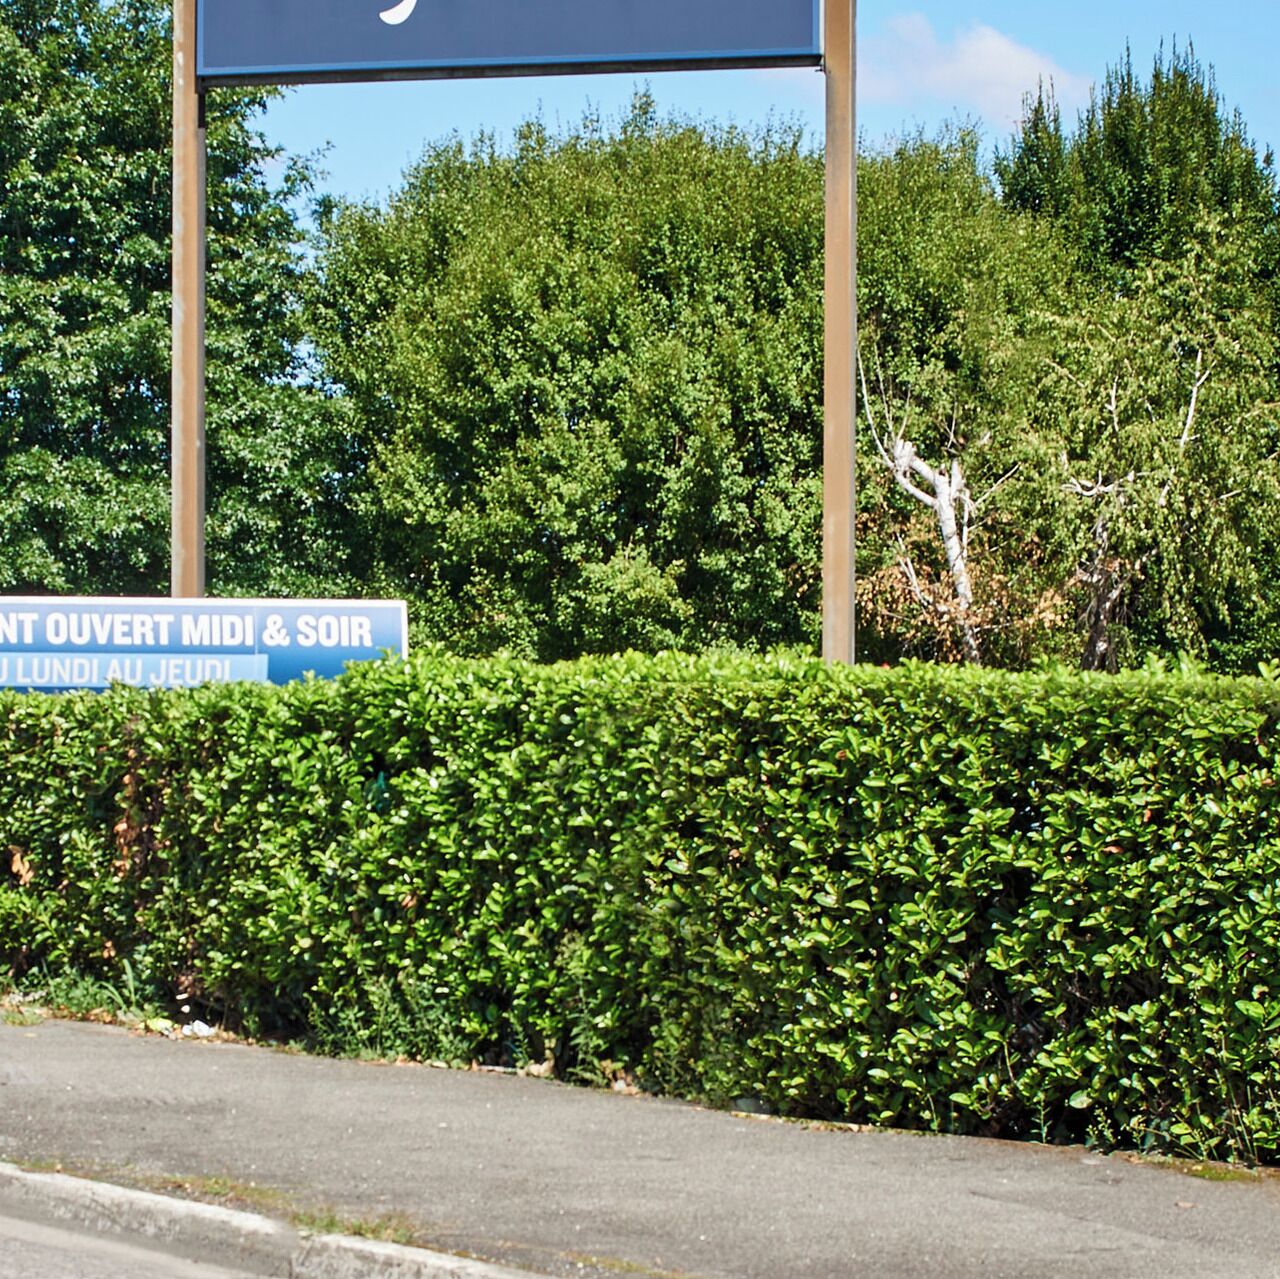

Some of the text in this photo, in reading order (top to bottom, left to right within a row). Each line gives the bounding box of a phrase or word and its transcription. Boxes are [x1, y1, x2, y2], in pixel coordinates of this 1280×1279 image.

[45, 613, 174, 646] OUVERT
[181, 615, 254, 646] MIDI
[262, 614, 290, 647] &
[296, 615, 372, 647] SOIR
[17, 658, 98, 684] LUNDI
[106, 658, 142, 684] AU
[149, 659, 231, 684] JEUDI
